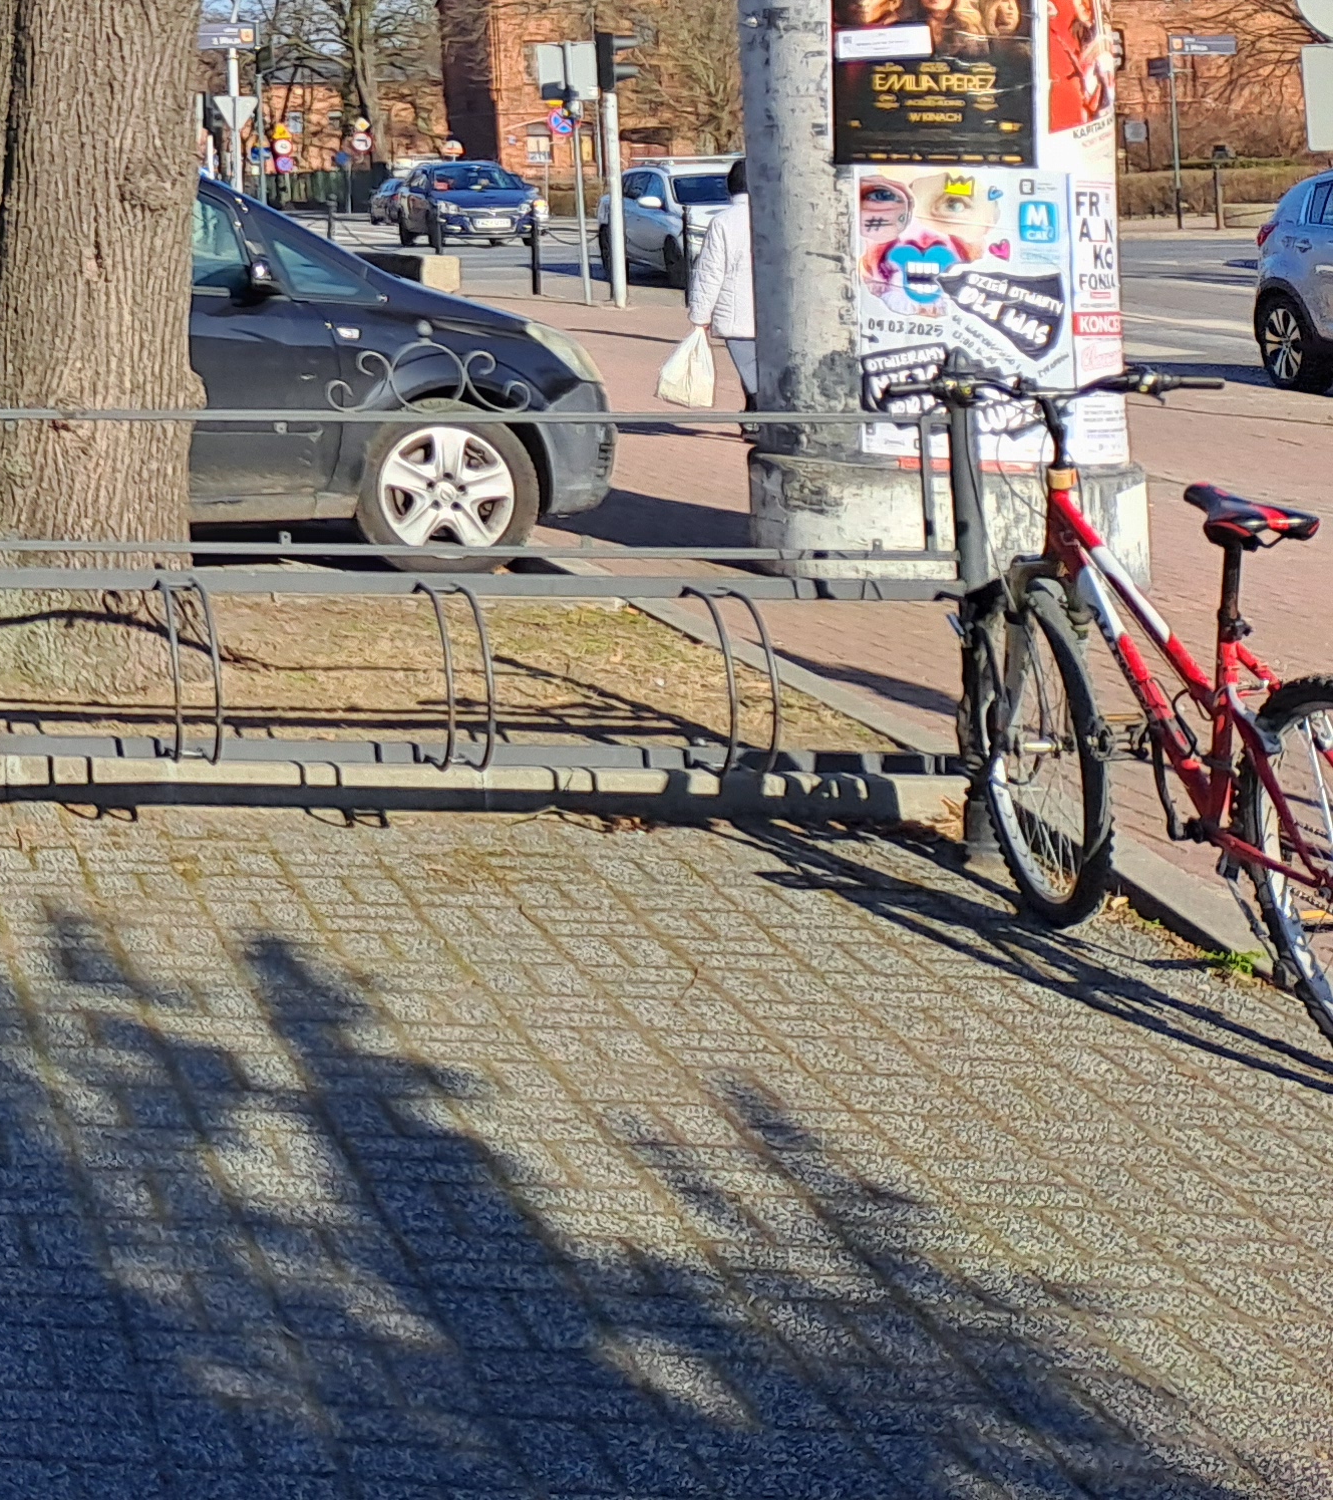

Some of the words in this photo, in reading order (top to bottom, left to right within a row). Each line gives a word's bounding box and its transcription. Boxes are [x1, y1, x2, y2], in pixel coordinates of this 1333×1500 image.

[872, 74, 940, 92] EMILIA
[922, 112, 963, 123] KINACH
[1009, 286, 1064, 318] OTWARTY
[957, 286, 1004, 320] DLA
[1002, 307, 1052, 345] WAS
[867, 318, 944, 338] 09.03.2025
[866, 347, 946, 372] OTWIERAMY
